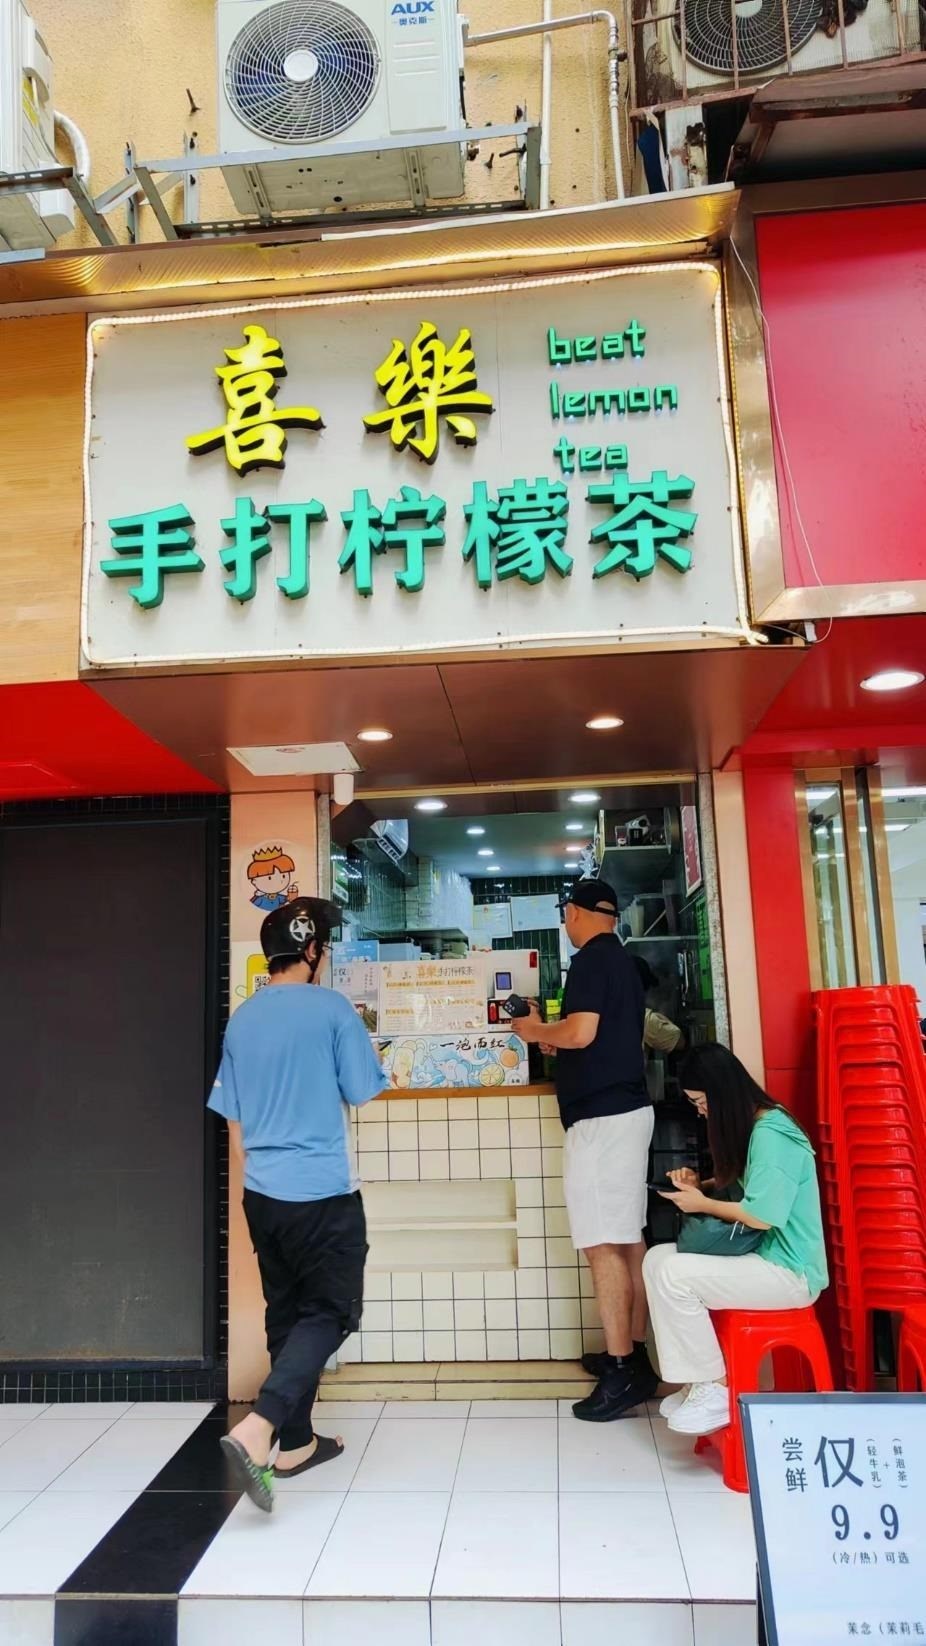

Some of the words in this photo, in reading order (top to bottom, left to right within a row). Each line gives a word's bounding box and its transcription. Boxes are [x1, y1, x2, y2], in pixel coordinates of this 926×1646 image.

[391, 1, 434, 15] AUX
[547, 319, 646, 365] beat
[184, 322, 496, 478] 喜樂
[550, 379, 678, 419] lemon
[553, 435, 629, 473] tea
[100, 470, 699, 609] 手打柠檬茶
[782, 1437, 808, 1493] 尝鲜
[814, 1436, 863, 1488] 仅
[831, 1504, 899, 1541] 9.9
